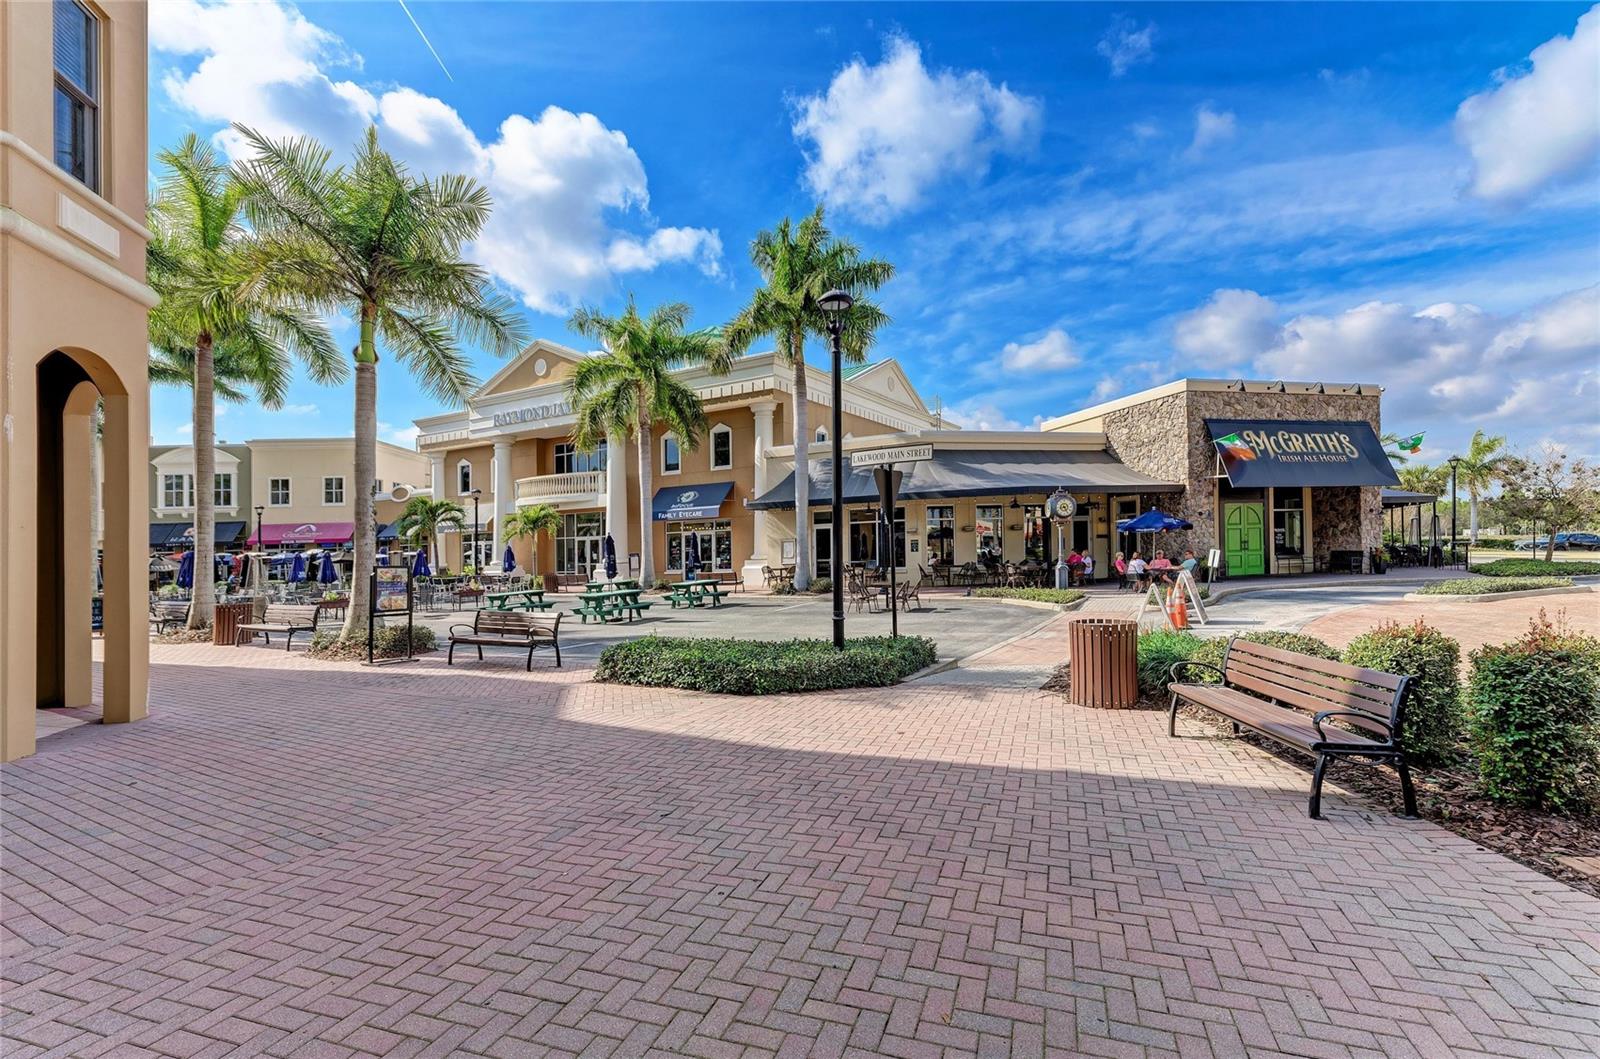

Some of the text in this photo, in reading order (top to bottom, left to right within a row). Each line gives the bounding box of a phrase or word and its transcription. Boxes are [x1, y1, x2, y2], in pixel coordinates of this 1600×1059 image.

[493, 404, 552, 427] RAYMOND
[1242, 430, 1359, 459] McGRATH'S
[853, 447, 931, 462] LAKEWOOD MAIN STREET
[1277, 454, 1349, 463] IRISH ALE HOUSE
[679, 510, 702, 518] EYECARE
